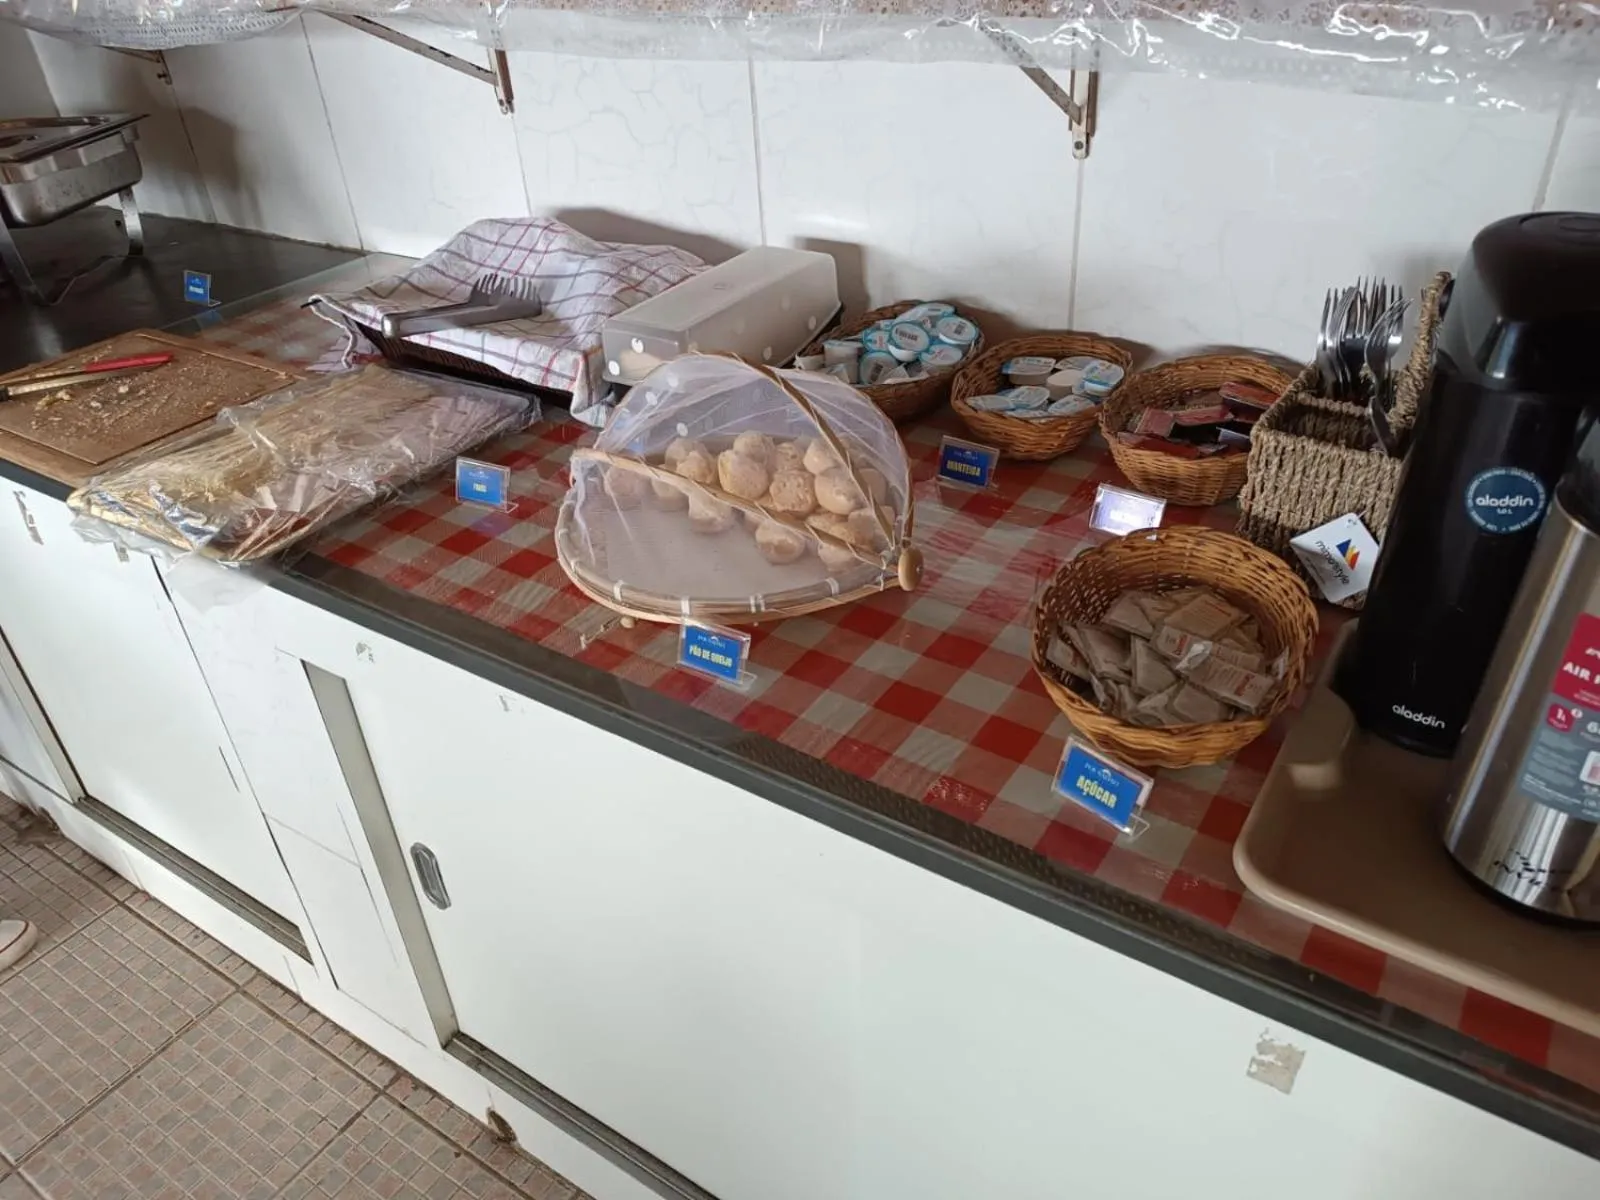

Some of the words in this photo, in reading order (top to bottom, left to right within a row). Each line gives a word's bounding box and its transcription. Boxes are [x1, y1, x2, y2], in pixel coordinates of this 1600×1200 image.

[1475, 494, 1534, 507] aladdin
[1563, 661, 1591, 681] AIR
[1392, 704, 1446, 729] aladdin
[1076, 775, 1117, 809] AÇÚCAR
